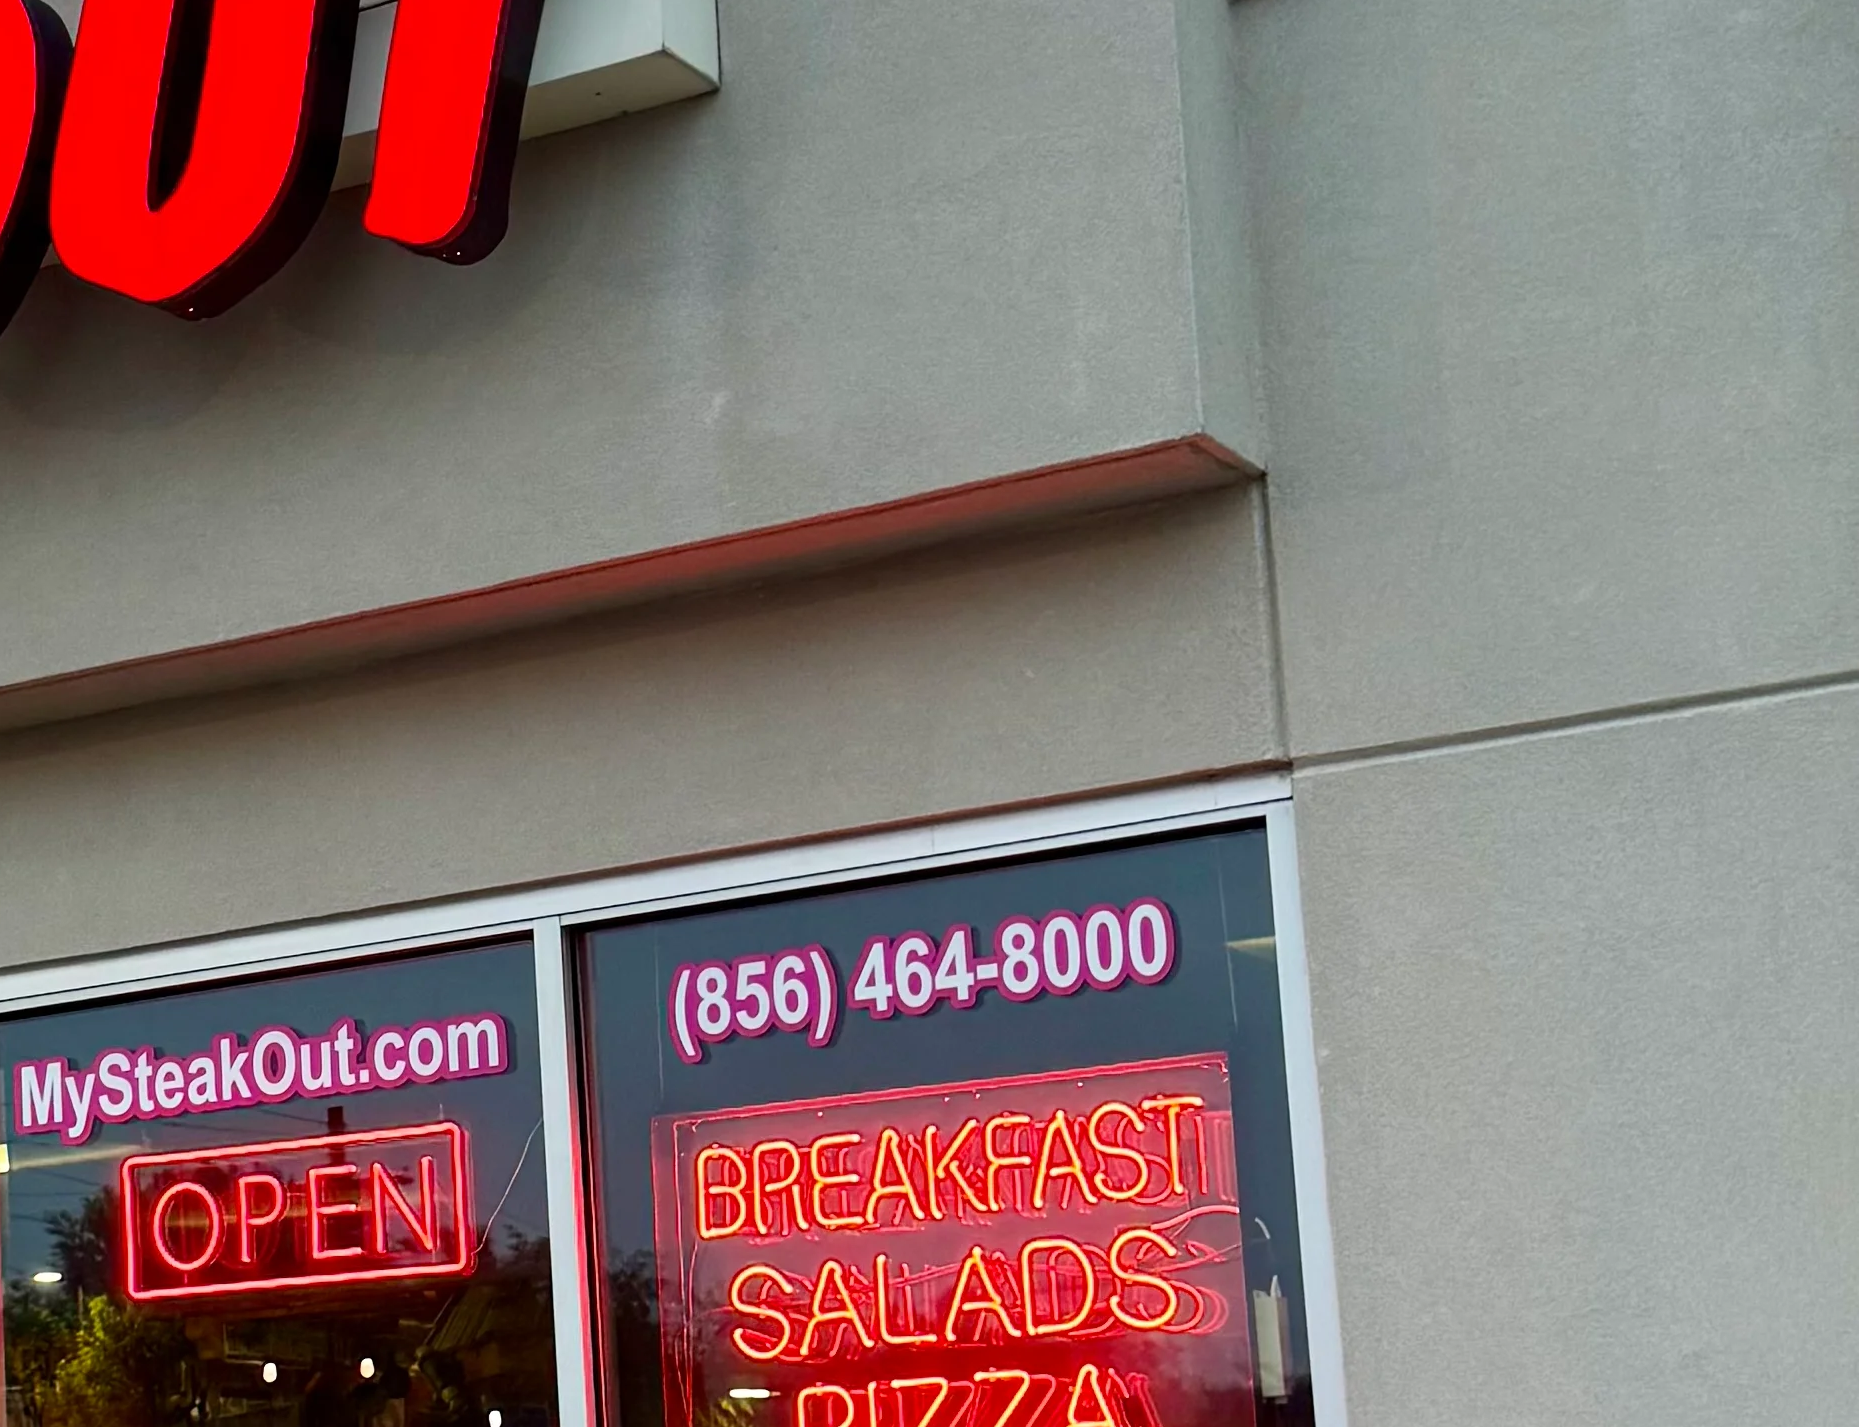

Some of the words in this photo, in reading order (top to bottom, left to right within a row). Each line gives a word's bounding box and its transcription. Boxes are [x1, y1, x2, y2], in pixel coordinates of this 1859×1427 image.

[675, 948, 835, 1058] (856)
[854, 904, 1169, 1012] 464-8000
[19, 1018, 501, 1139] MySteakOut.com
[152, 1156, 438, 1271] OPEN
[695, 1095, 1203, 1240] BREAKFAST
[729, 1228, 1179, 1360] SALADS
